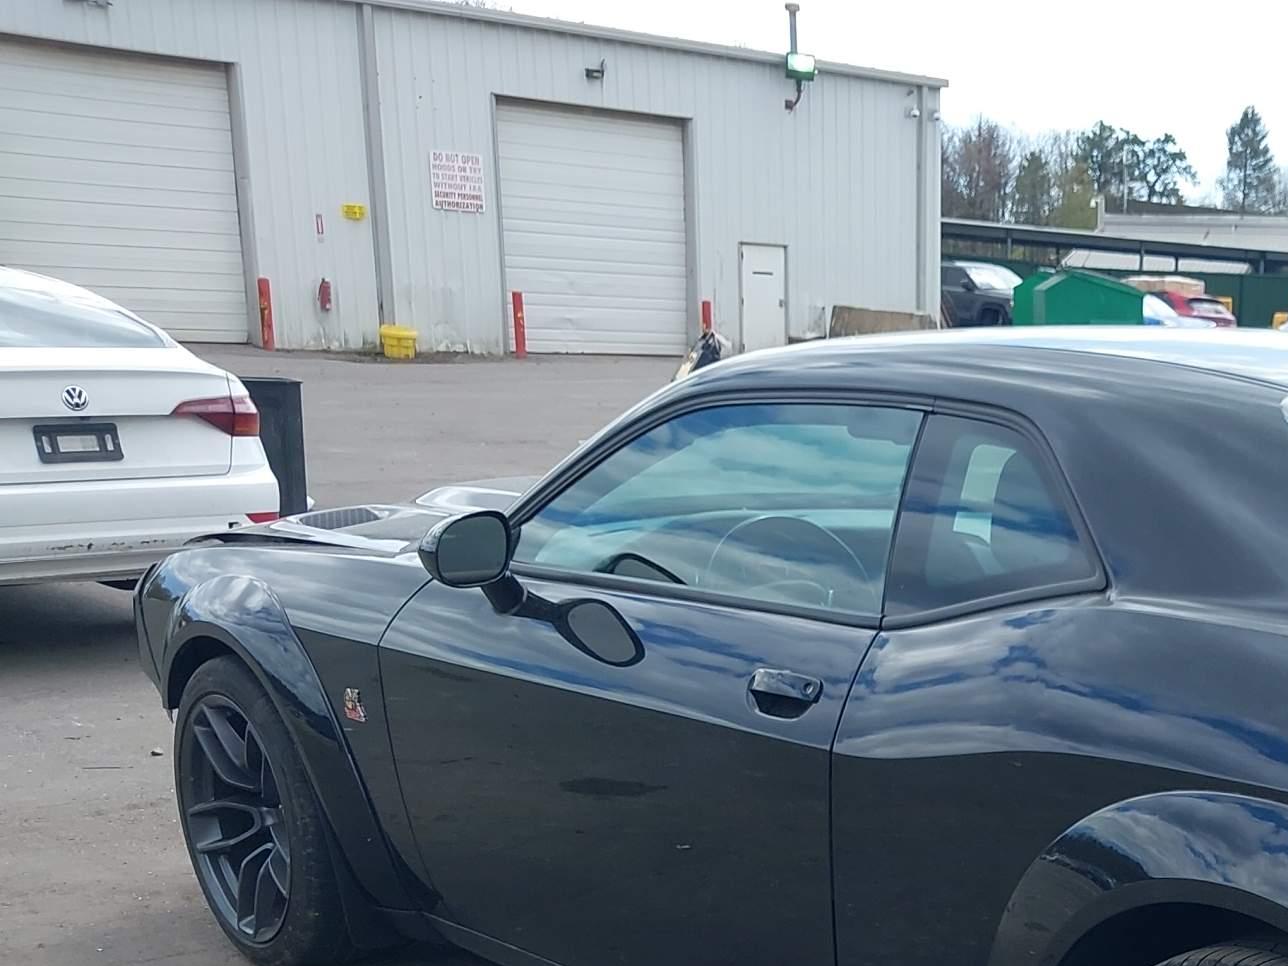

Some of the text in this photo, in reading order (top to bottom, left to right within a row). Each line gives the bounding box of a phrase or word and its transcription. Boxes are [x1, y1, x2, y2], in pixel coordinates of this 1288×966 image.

[433, 152, 480, 166] DO NOT OPEN
[432, 163, 455, 172] HOODS
[432, 172, 483, 184] TO START VEHICLES
[433, 182, 466, 191] WITHOUT
[434, 190, 483, 201] SECURITY PERSONNEL
[435, 200, 483, 210] AUTHORIZATION
